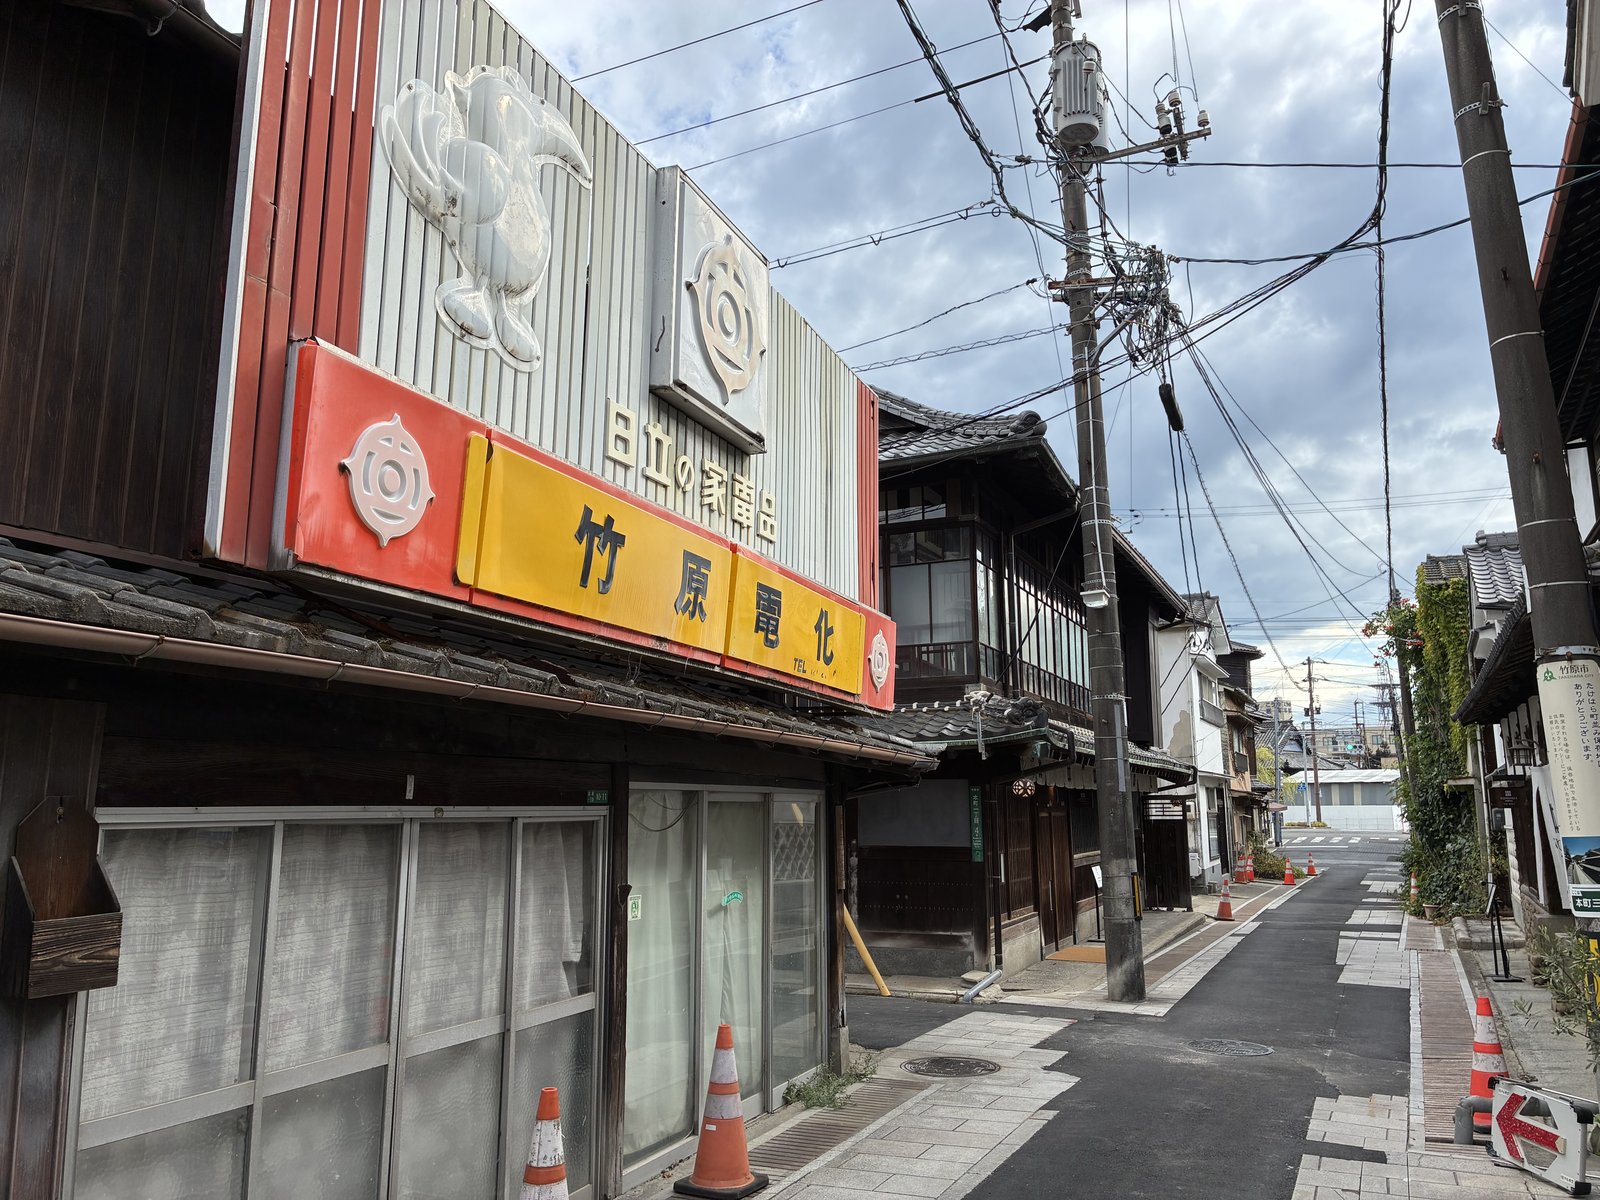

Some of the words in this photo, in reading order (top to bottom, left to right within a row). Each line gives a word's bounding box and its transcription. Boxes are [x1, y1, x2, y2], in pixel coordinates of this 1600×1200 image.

[605, 397, 777, 544] 日立の家電品
[574, 504, 834, 667] 竹原電化
[793, 657, 807, 674] TEL
[1559, 664, 1589, 675] 竹原市
[1573, 682, 1593, 763] ありがとうございます。
